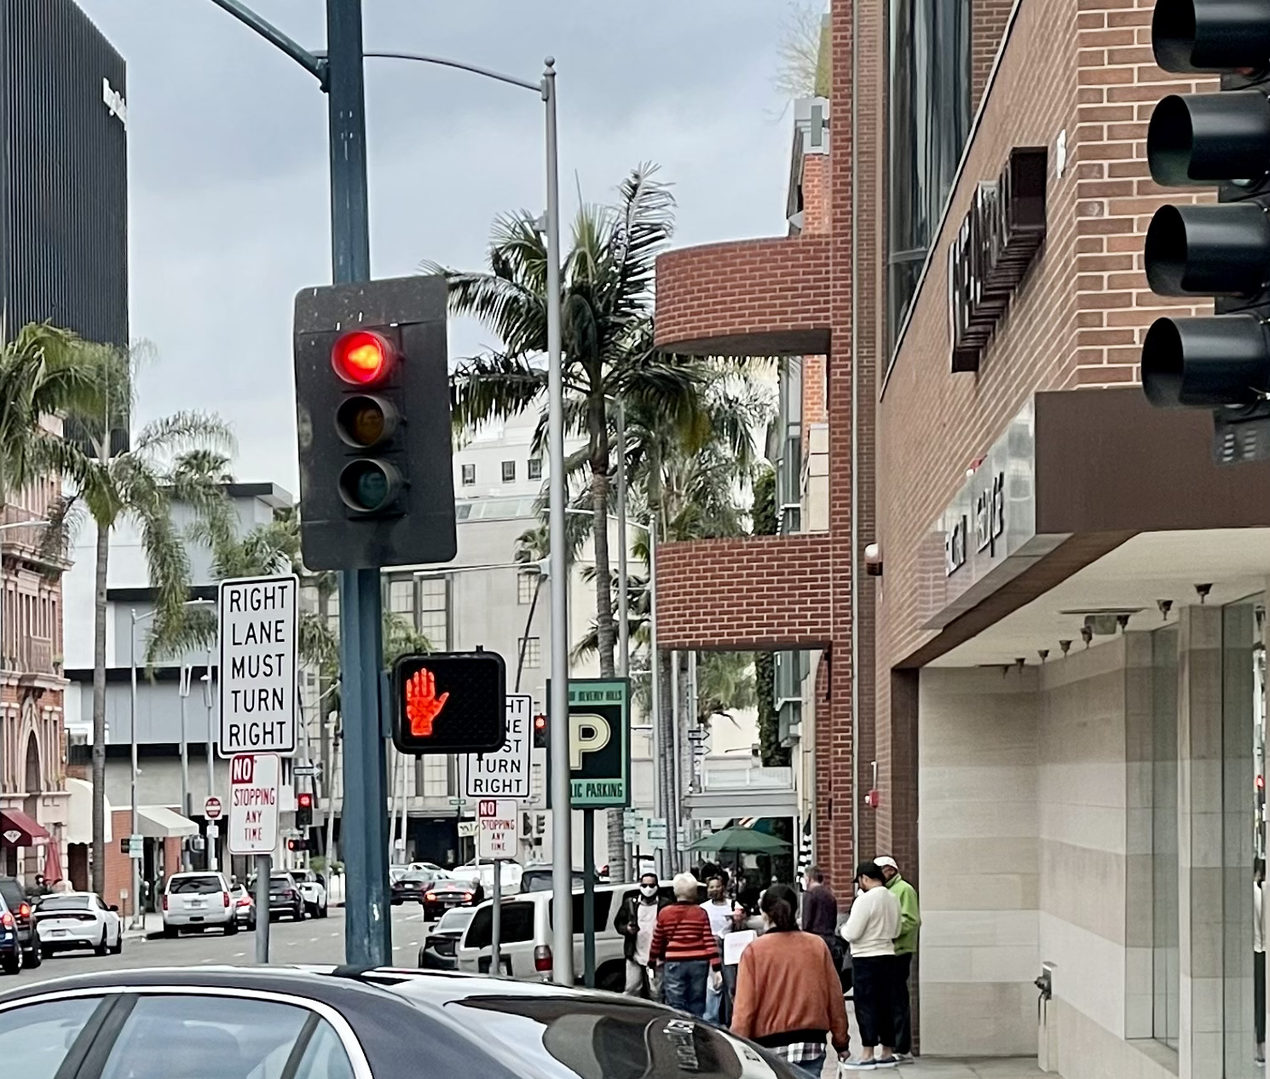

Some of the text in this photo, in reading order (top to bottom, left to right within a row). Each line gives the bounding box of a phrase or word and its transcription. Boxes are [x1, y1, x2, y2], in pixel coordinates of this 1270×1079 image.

[230, 585, 287, 612] RIGHT
[232, 619, 285, 646] LANE
[231, 653, 285, 679] MUST
[231, 687, 284, 713] TURN
[578, 690, 604, 701] BEVERLY
[606, 689, 622, 701] HILLS
[229, 721, 286, 747] RIGHT
[503, 740, 522, 753] ST
[568, 713, 611, 770] P
[233, 758, 252, 781] NO
[476, 759, 521, 773] TURN
[473, 779, 523, 793] RIGHT
[571, 783, 623, 798] LIC PARKING
[234, 787, 275, 806] STOPPING
[480, 802, 495, 815] NO
[245, 810, 262, 823] ANY
[481, 819, 515, 830] STOPPING
[244, 827, 262, 841] TIME
[491, 833, 505, 841] ANY
[491, 843, 506, 851] TIME
